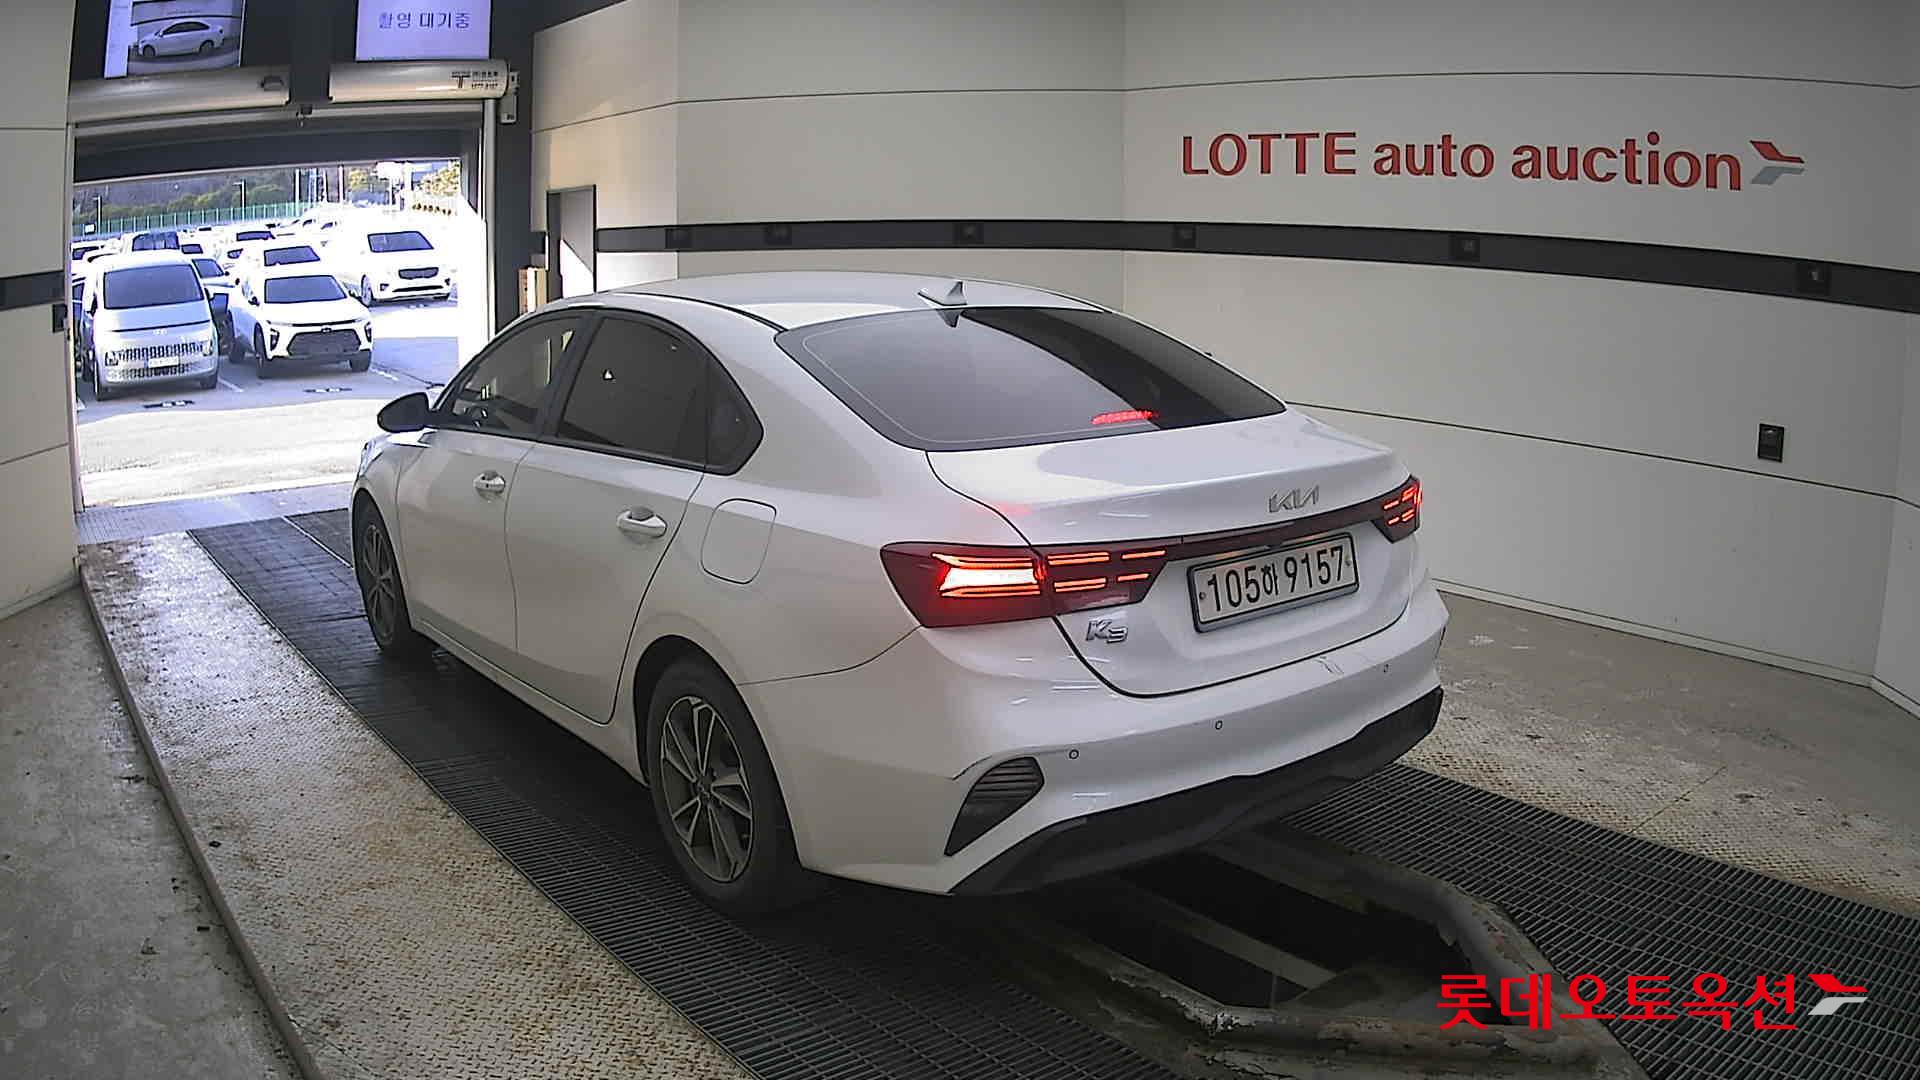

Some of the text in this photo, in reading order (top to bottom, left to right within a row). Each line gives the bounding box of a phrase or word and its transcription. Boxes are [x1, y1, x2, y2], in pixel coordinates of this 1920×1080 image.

[419, 12, 471, 29] 대기중
[1183, 131, 1742, 190] LOTTE auto auction
[1268, 484, 1320, 513] KIA
[1207, 545, 1344, 612] 105하 9157
[1086, 618, 1129, 644] K3
